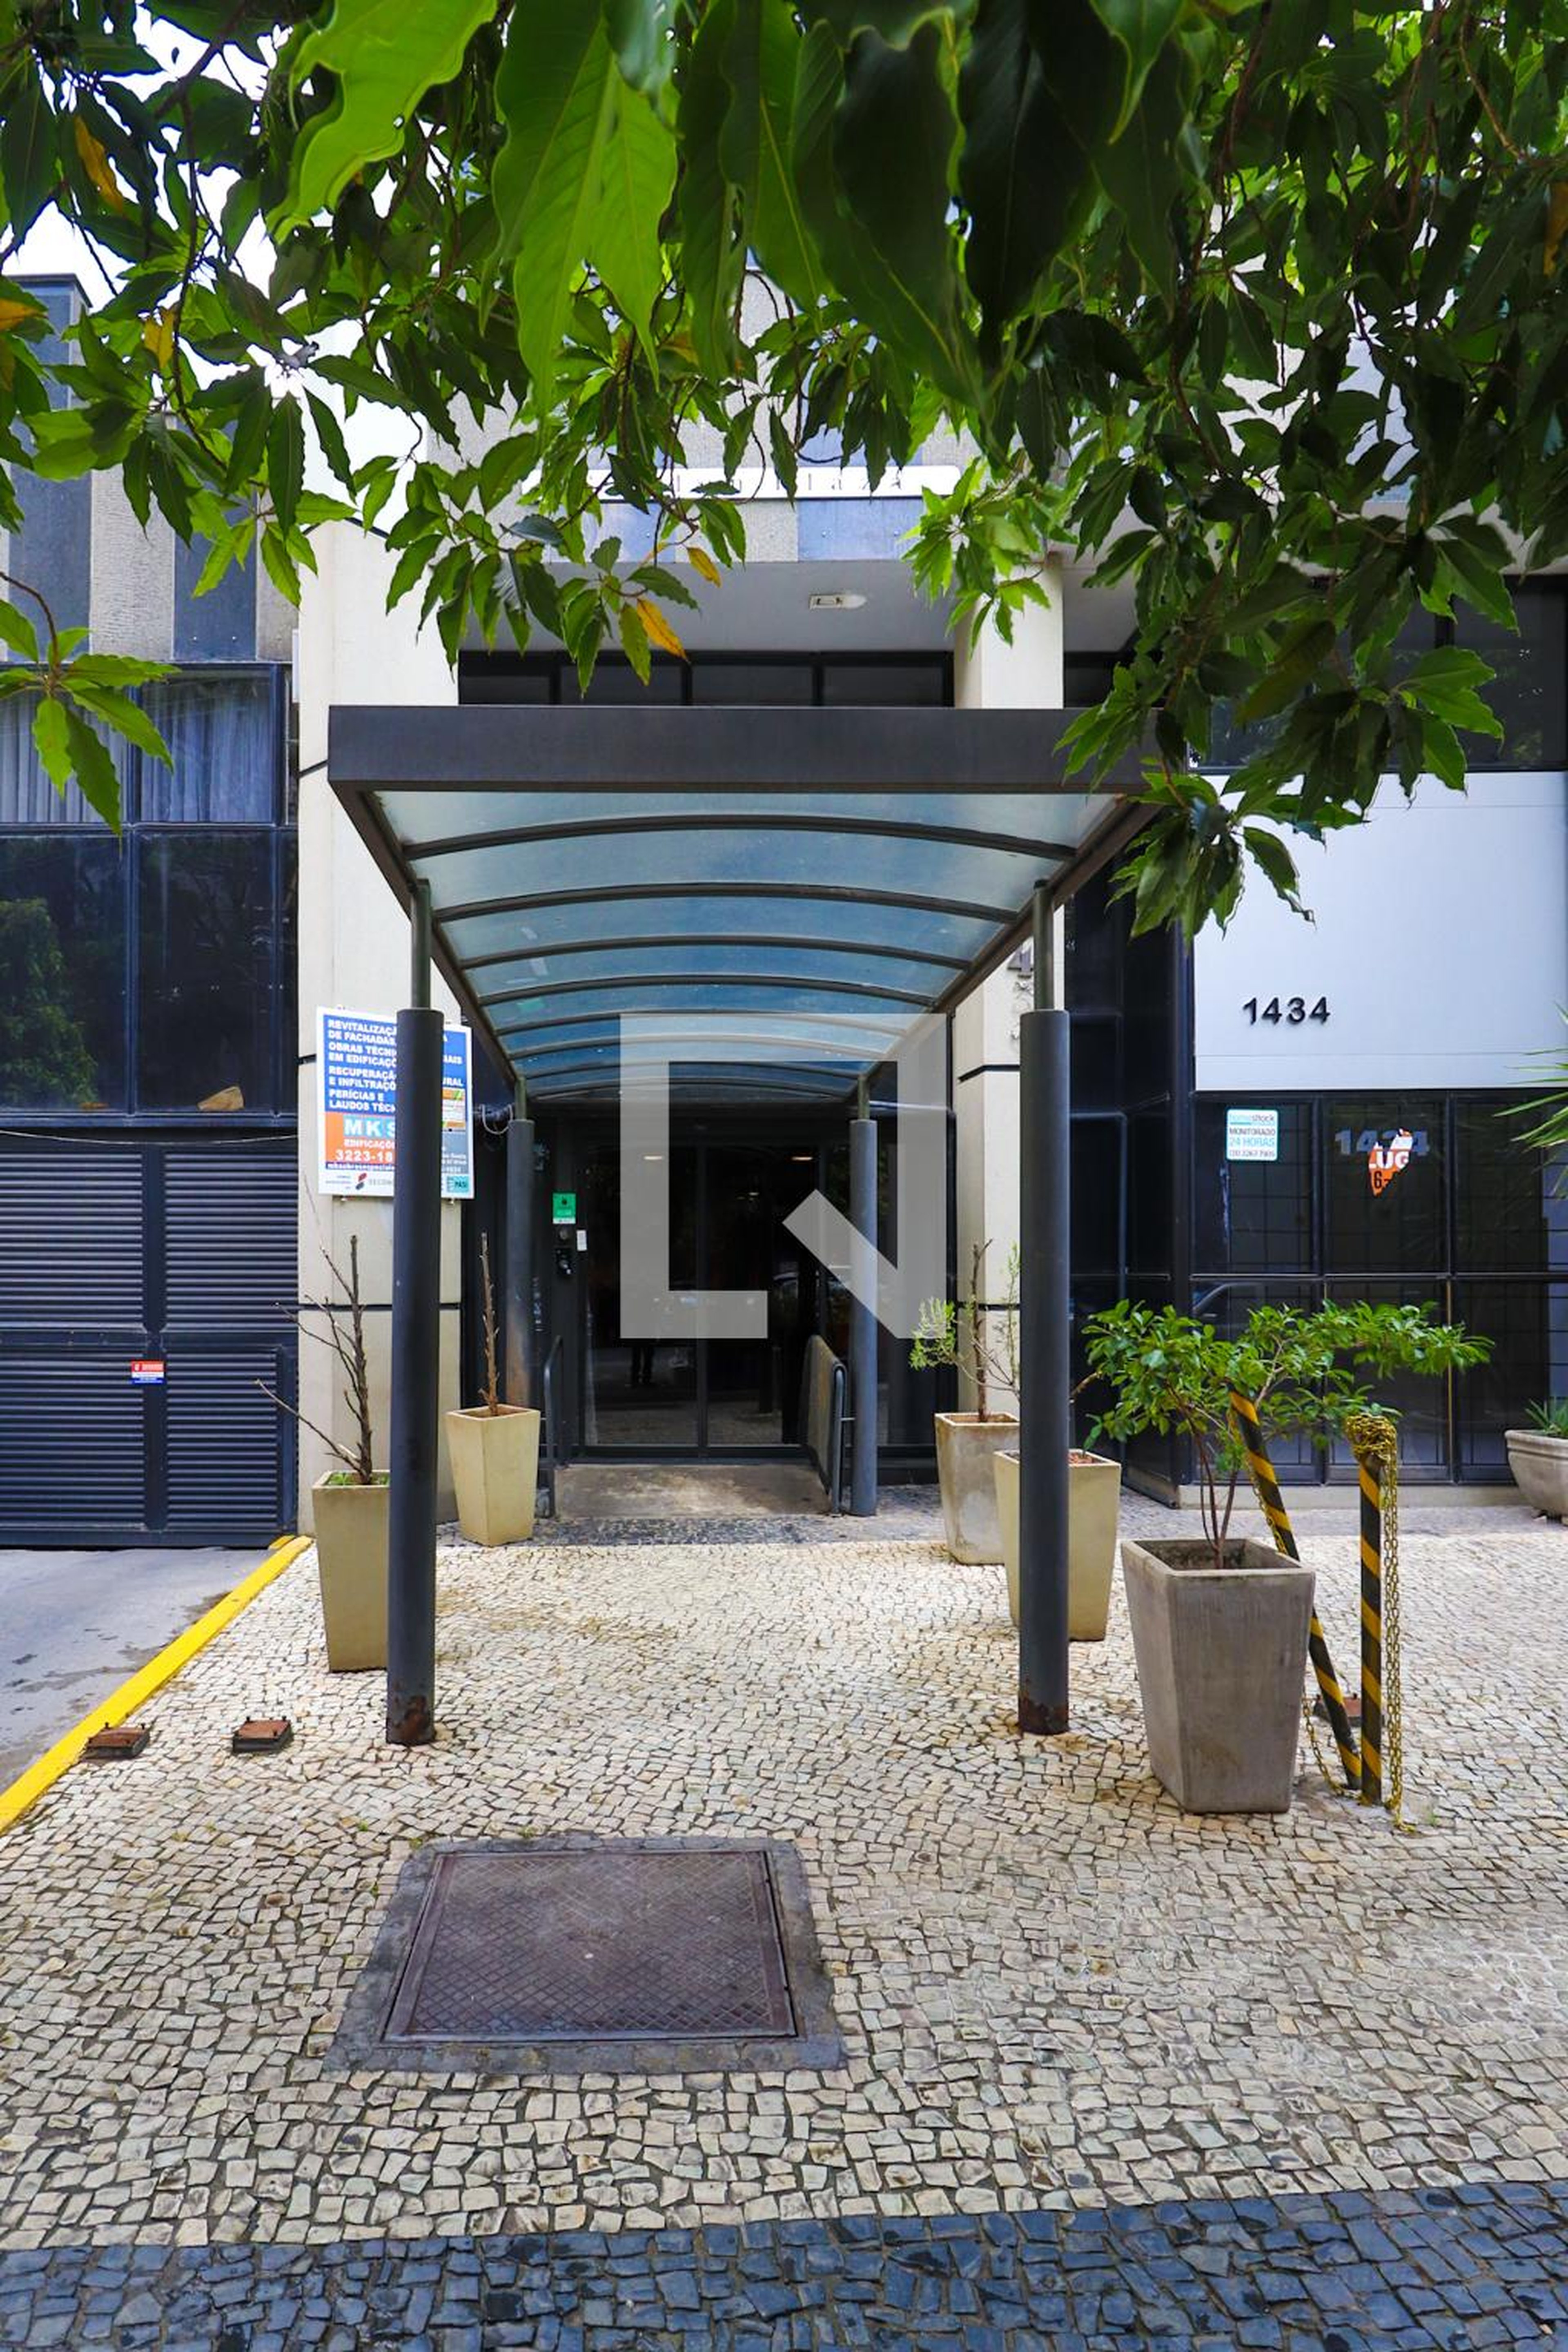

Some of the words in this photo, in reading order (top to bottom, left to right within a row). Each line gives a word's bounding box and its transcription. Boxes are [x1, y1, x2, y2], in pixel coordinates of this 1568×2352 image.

[1243, 996, 1331, 1025] 1434
[328, 1030, 342, 1039] DE
[328, 1041, 363, 1054] OBRAS
[329, 1051, 343, 1062] EM
[329, 1065, 396, 1081] RECUPERAÇÃ
[329, 1076, 336, 1086] E
[338, 1077, 396, 1091] INFILTRAÇÕ
[329, 1089, 375, 1101] PERÍCIAS
[377, 1092, 384, 1102] E
[330, 1100, 370, 1111] LAUDOS
[1242, 1137, 1275, 1147] HORAS
[335, 1149, 393, 1162] 3223-18
[1369, 1150, 1409, 1170] UG
